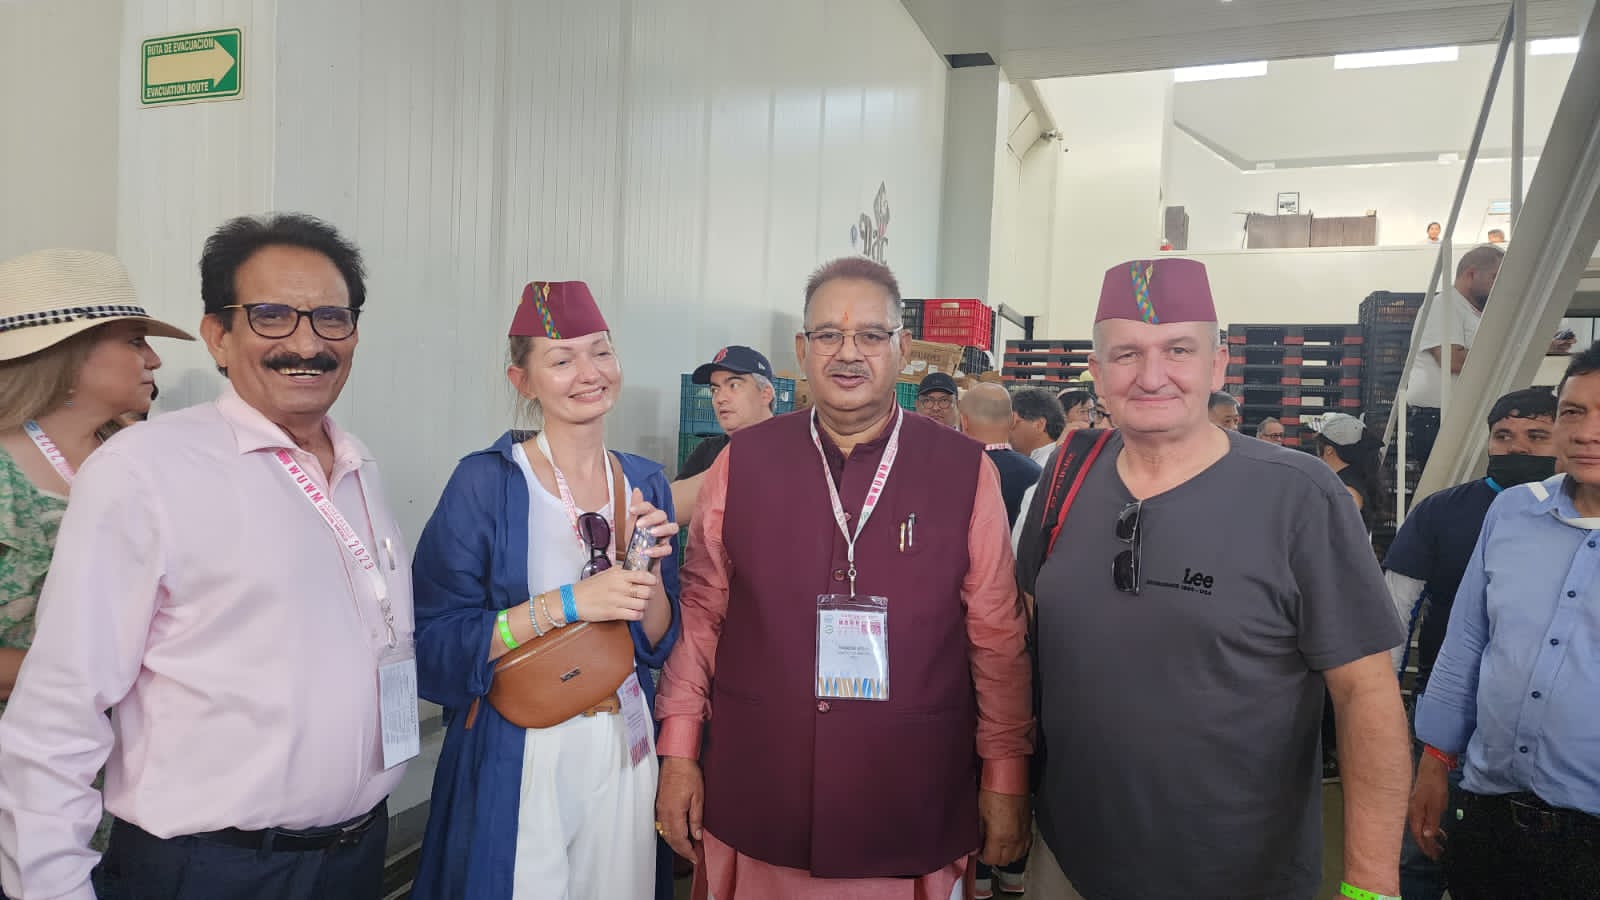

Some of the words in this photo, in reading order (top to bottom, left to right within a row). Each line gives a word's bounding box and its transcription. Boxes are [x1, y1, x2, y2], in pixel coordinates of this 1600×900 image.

[147, 44, 163, 56] RUTA
[164, 43, 172, 53] DE
[147, 84, 186, 97] EVACUATION
[187, 81, 209, 94] ROUTE
[289, 465, 324, 503] WUWM
[348, 540, 374, 570] 2023
[1183, 568, 1214, 589] Lee
